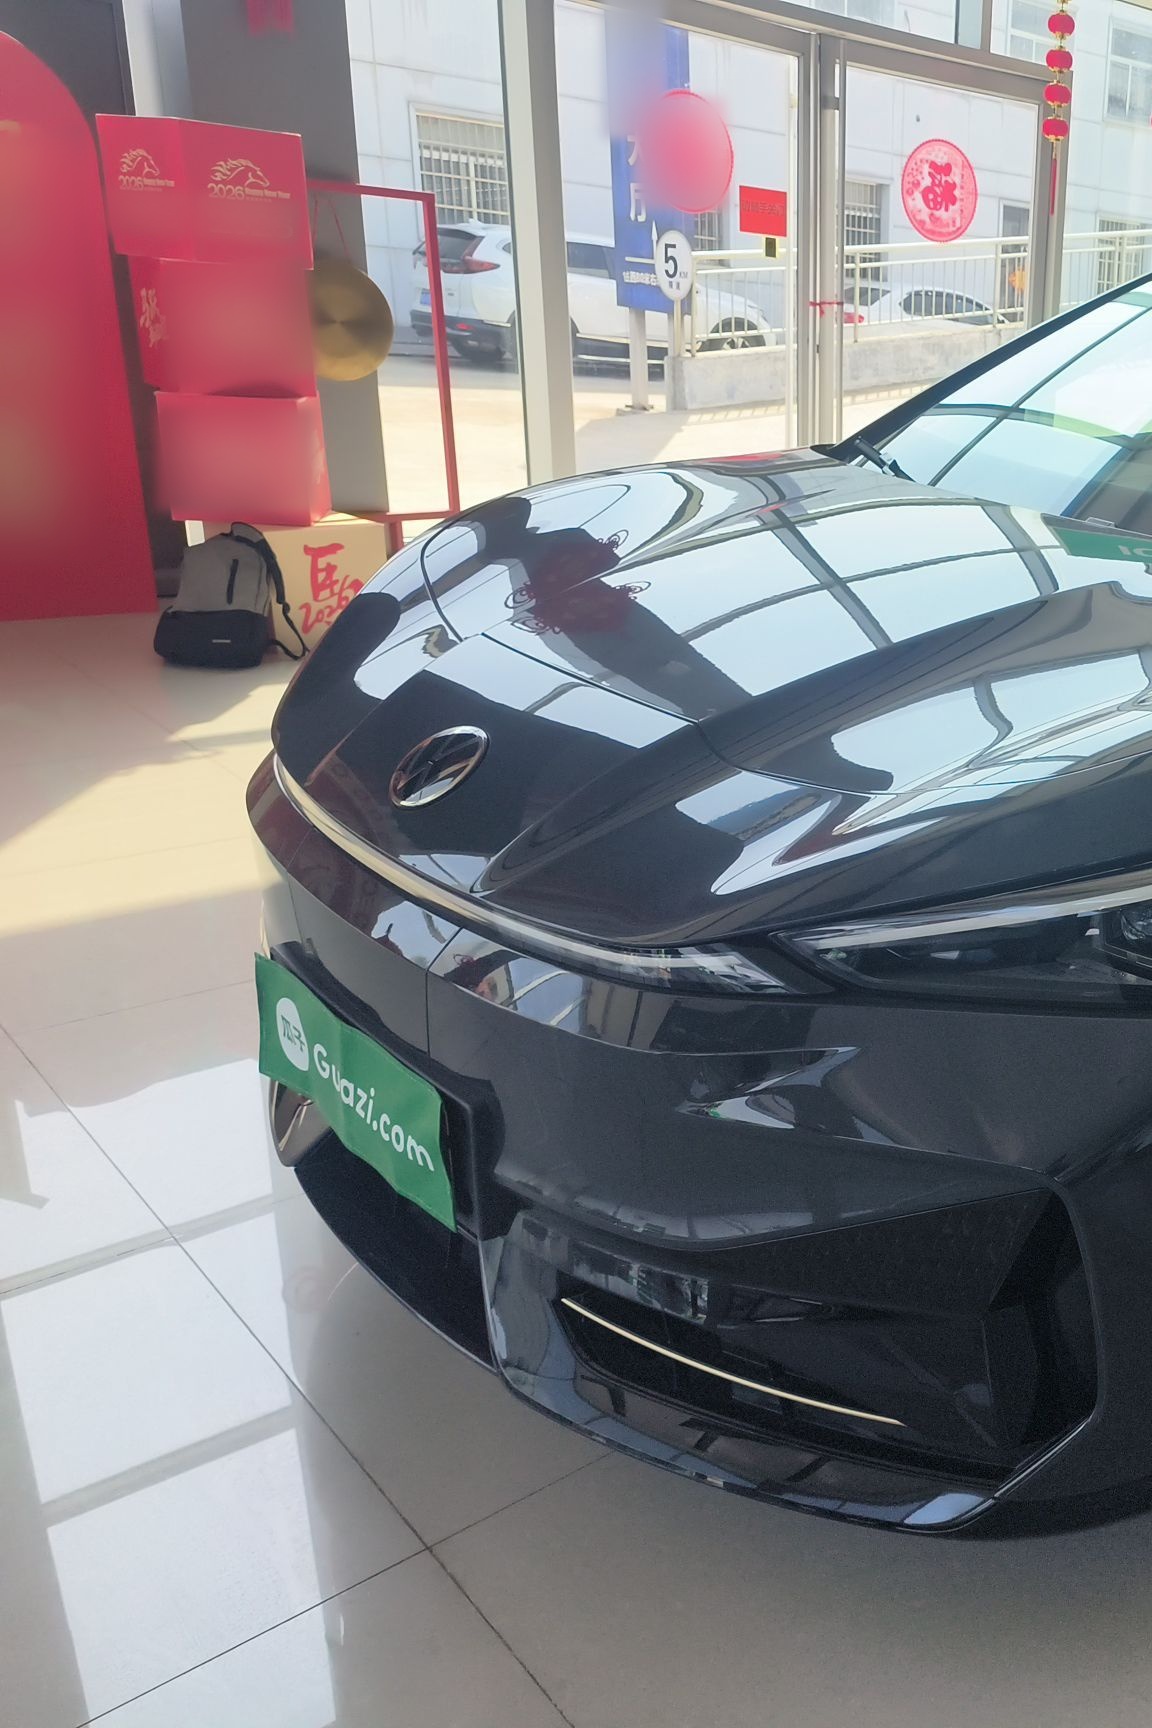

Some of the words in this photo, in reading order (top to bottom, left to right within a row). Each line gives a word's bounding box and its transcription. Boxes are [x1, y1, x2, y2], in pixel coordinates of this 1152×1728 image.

[118, 175, 144, 191] 2026
[207, 183, 245, 200] 2026
[664, 243, 678, 279] 5
[313, 1043, 435, 1172] Guazi.com
